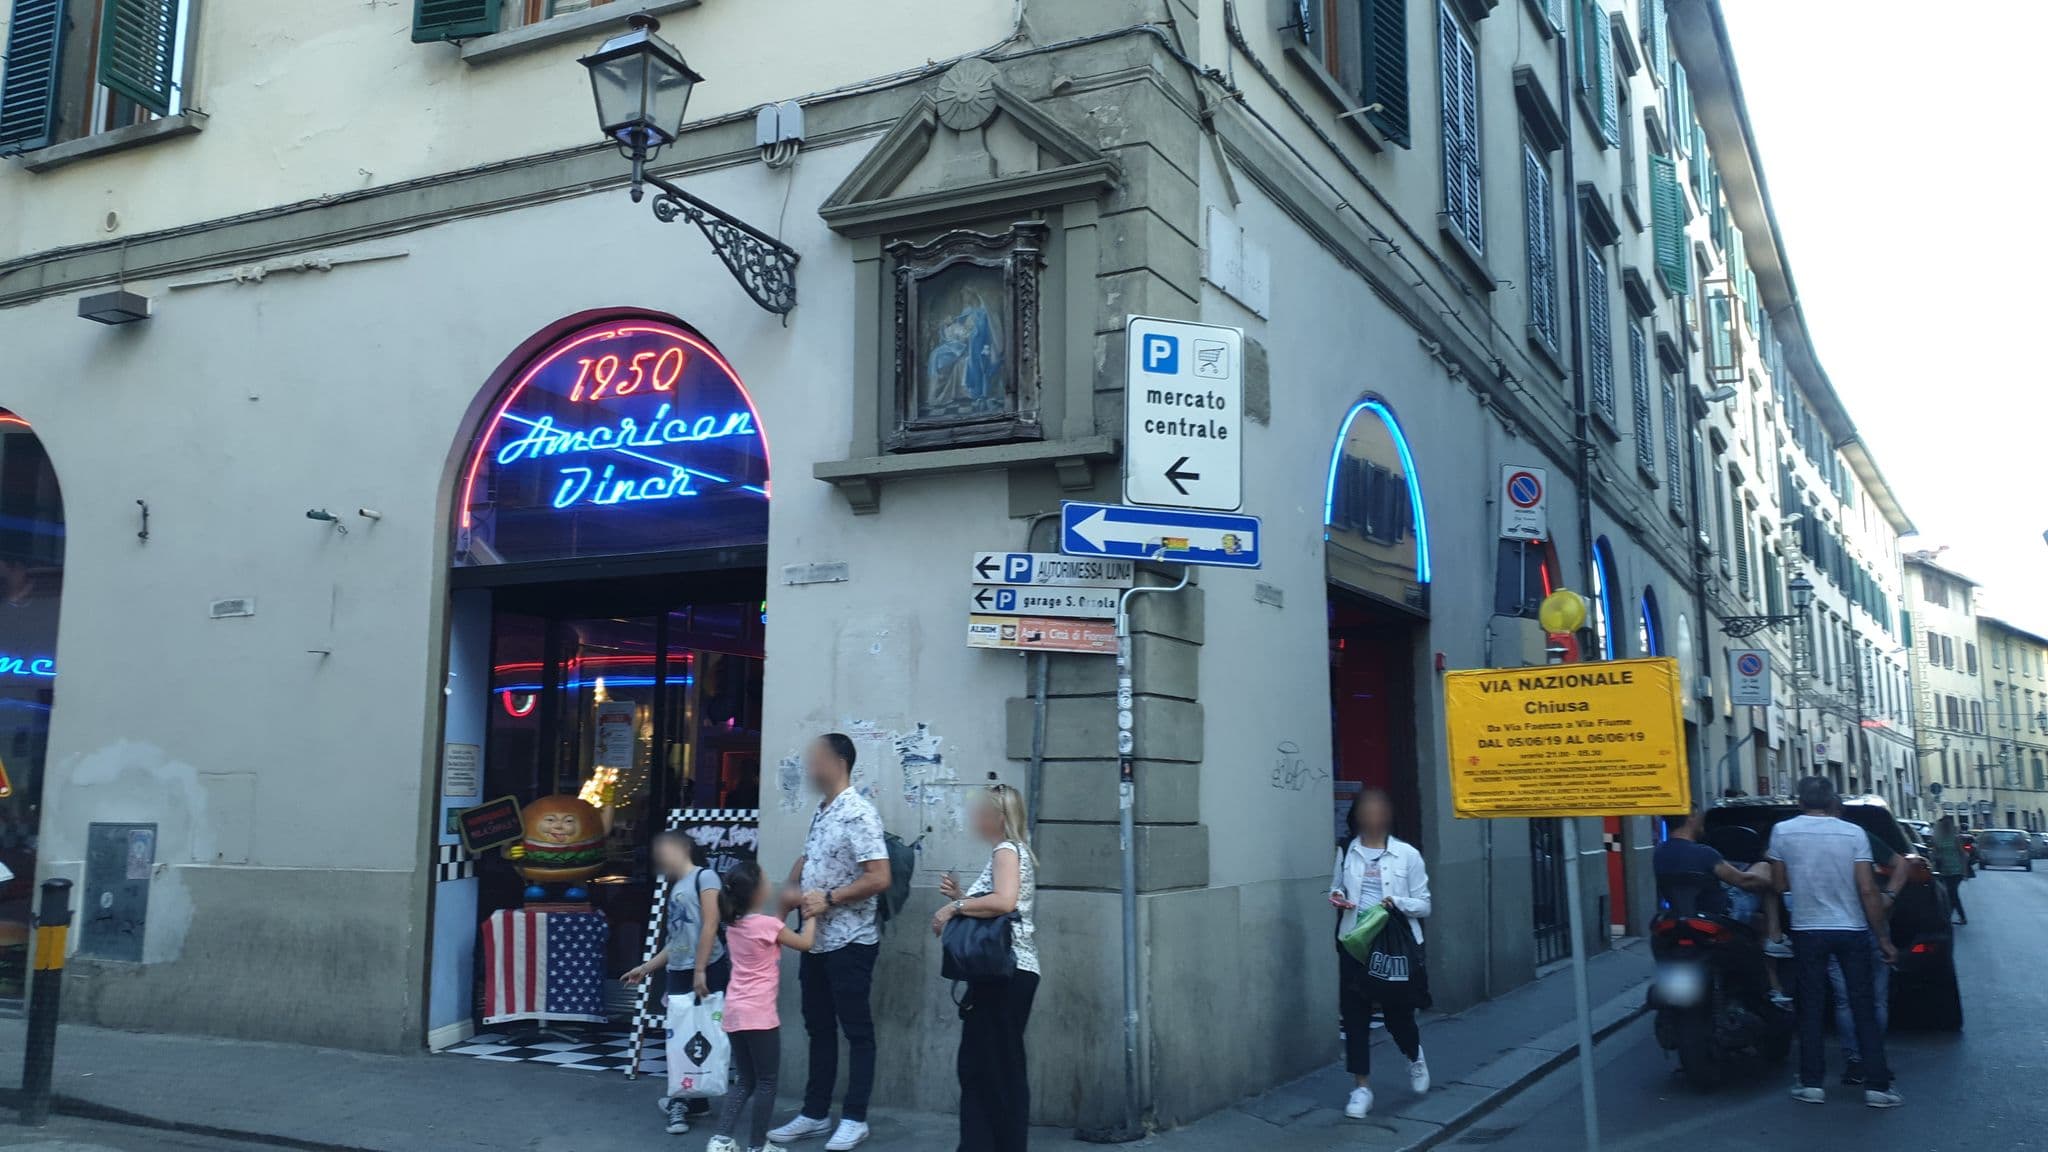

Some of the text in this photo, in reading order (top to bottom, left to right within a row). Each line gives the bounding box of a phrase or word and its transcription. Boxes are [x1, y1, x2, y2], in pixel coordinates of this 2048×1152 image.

[1149, 339, 1172, 368] P
[570, 347, 684, 402] 1950
[1147, 389, 1225, 410] mercato
[497, 403, 756, 465] American
[1144, 417, 1228, 440] centrale
[553, 464, 698, 509] Diner
[1010, 557, 1131, 580] P AUTORIMESSA LUNA
[1023, 597, 1061, 609] garage
[1065, 595, 1076, 607] S.
[1479, 671, 1634, 694] VIA NAZIONALE
[1524, 700, 1590, 715] Chiusa
[1504, 723, 1521, 731] Via
[1524, 722, 1563, 730] Faenza
[1575, 719, 1594, 728] Via
[1597, 718, 1632, 727] Fiume
[1478, 739, 1503, 749] DAL
[1565, 735, 1584, 745] AL
